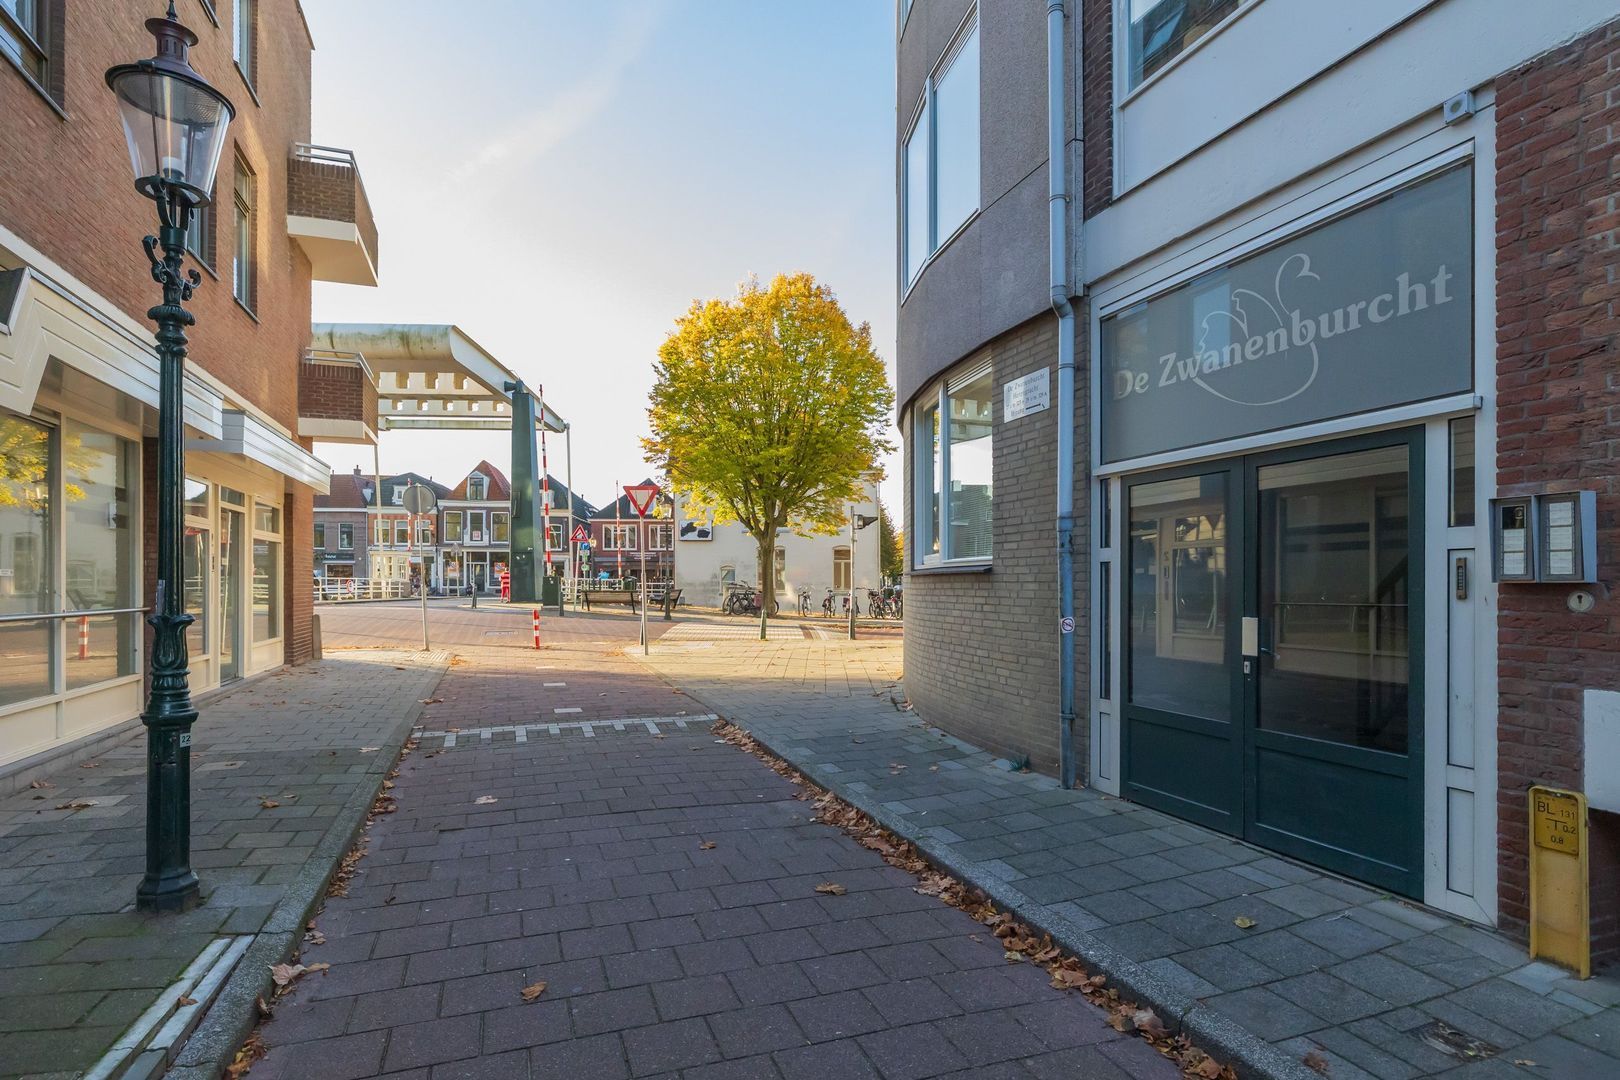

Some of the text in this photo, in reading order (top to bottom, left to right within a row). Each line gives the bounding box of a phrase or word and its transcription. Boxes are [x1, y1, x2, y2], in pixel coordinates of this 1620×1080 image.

[1114, 264, 1453, 400] De Zwanenburcht
[1537, 801, 1575, 820] BL 131
[1562, 825, 1577, 835] 0.2
[1551, 835, 1564, 845] 0.8
